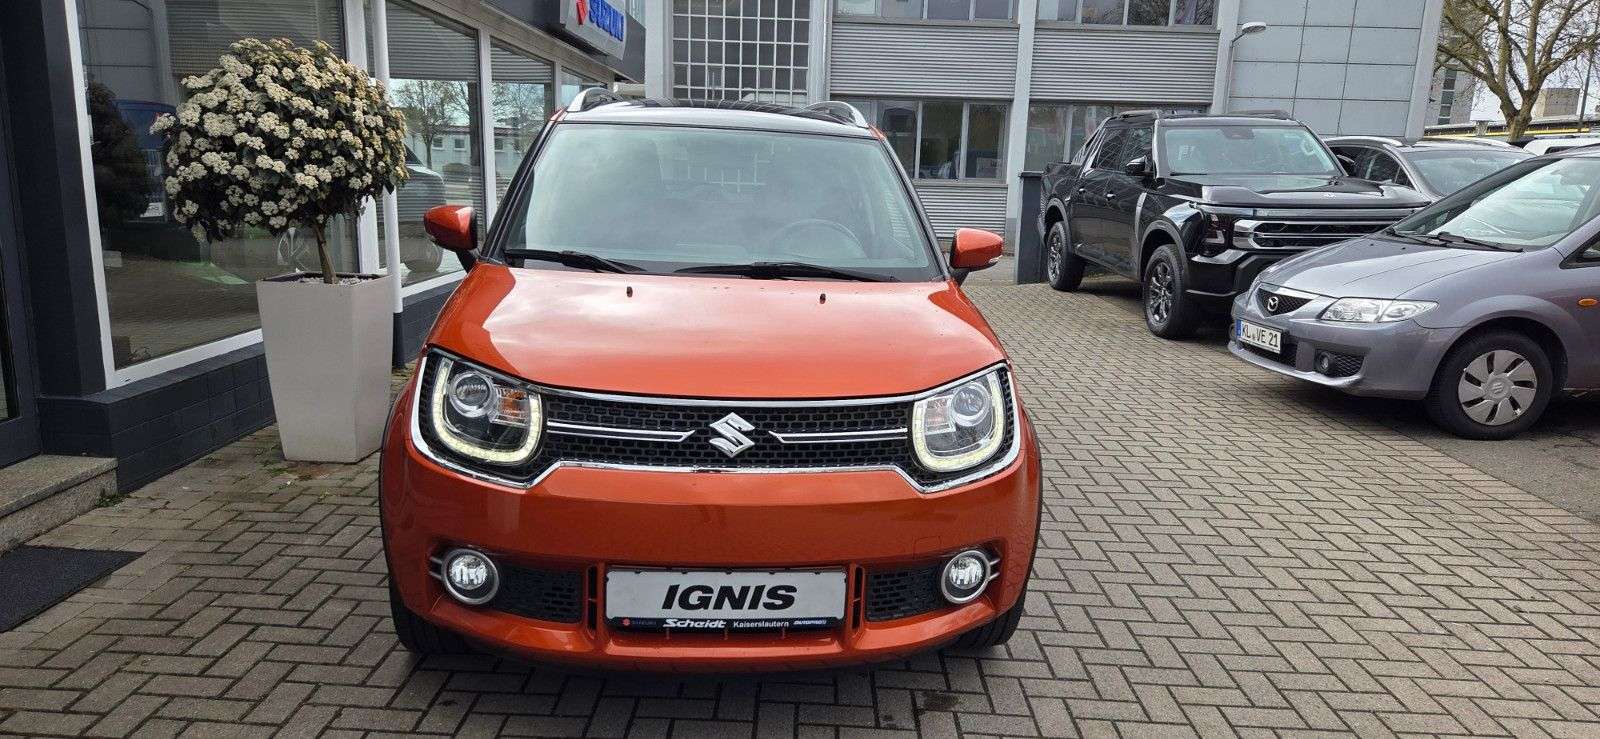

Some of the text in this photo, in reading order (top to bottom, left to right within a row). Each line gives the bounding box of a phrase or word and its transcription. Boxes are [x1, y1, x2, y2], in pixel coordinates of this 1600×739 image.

[589, 0, 624, 41] SUZUKI
[1256, 328, 1266, 343] VE
[1268, 332, 1278, 347] 21
[661, 584, 798, 611] IGNIS
[662, 618, 727, 628] Scheidt
[733, 619, 790, 629] Kaiserslautern
